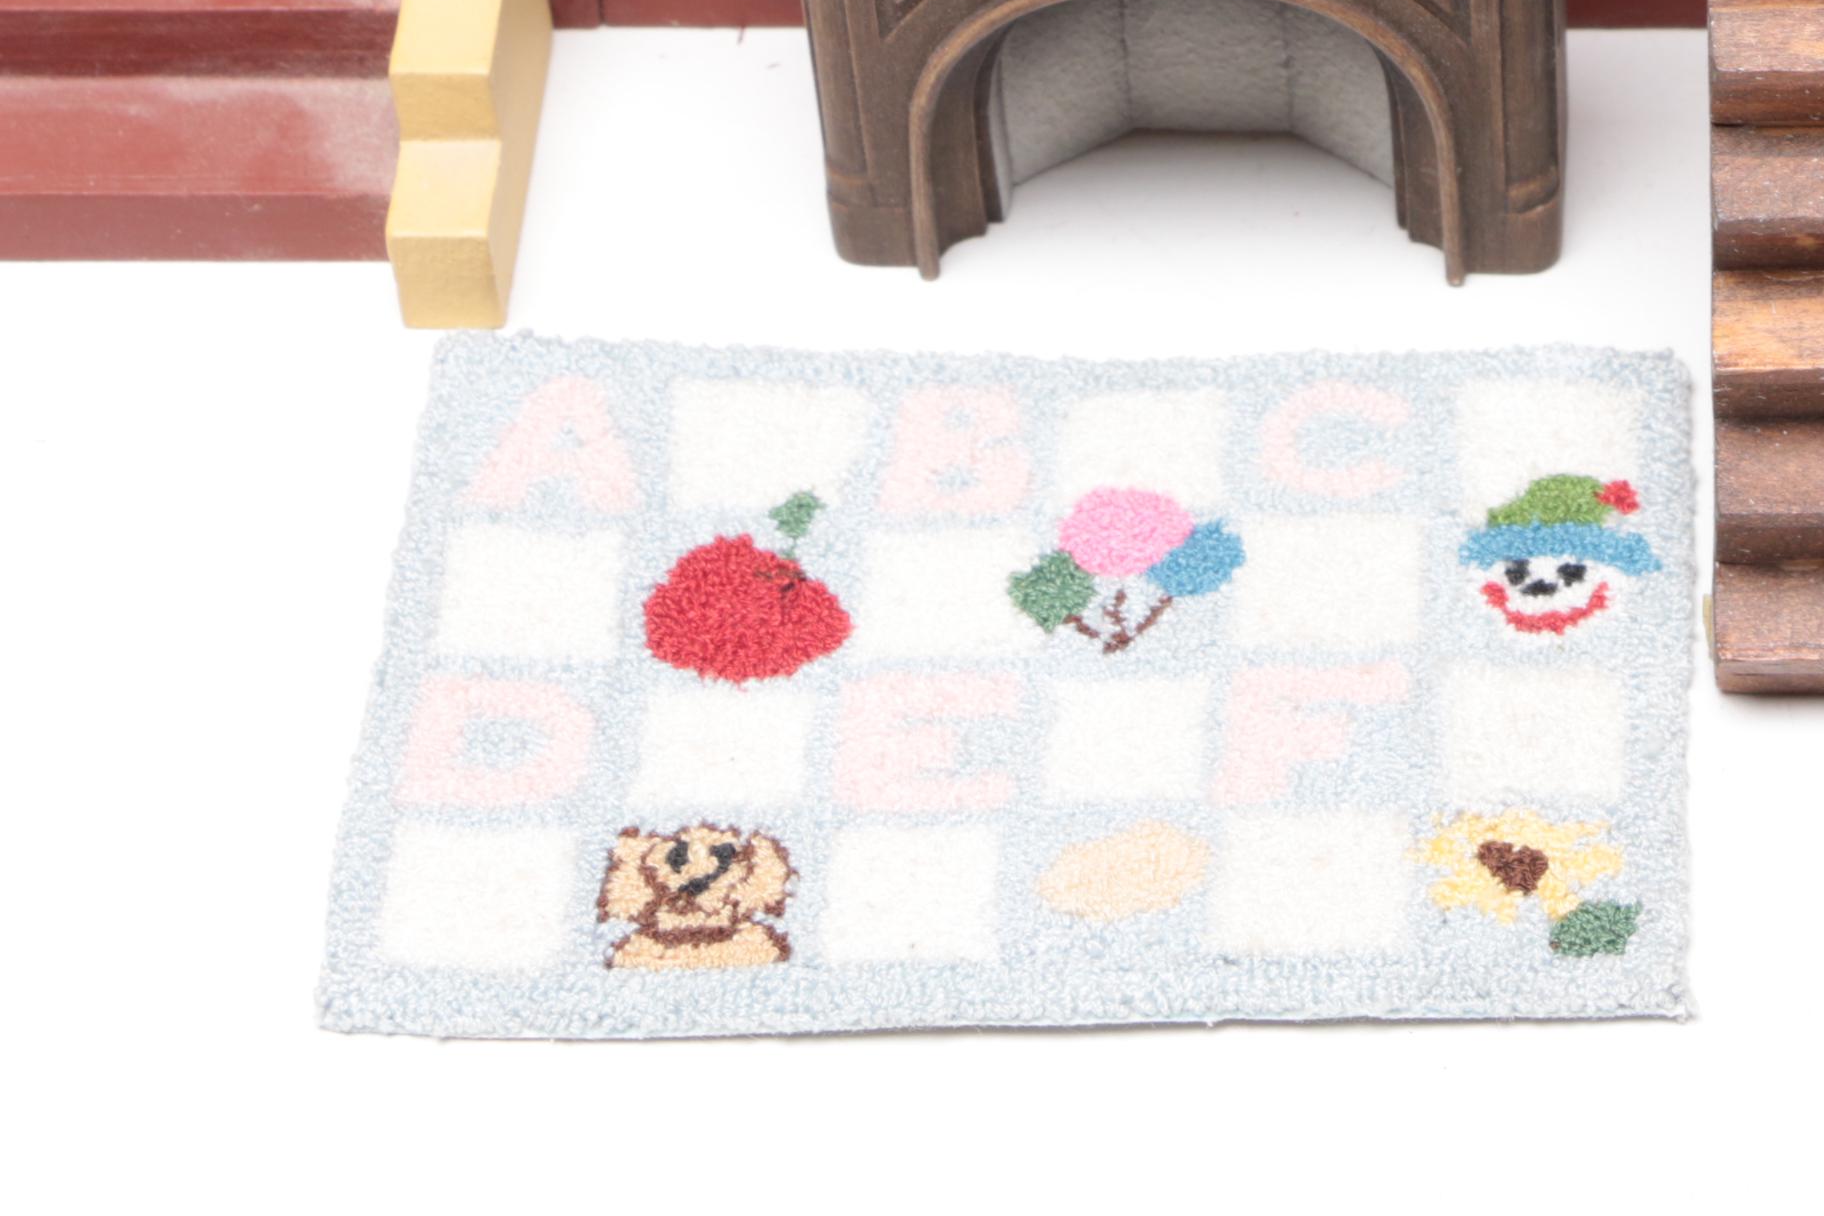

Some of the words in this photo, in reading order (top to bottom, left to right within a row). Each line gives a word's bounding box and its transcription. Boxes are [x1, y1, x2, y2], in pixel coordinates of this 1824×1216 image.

[461, 375, 641, 515] A
[874, 382, 1037, 517] B
[1258, 381, 1411, 499] C
[393, 671, 598, 809] D
[831, 667, 1023, 814] E
[1208, 659, 1409, 807] F
